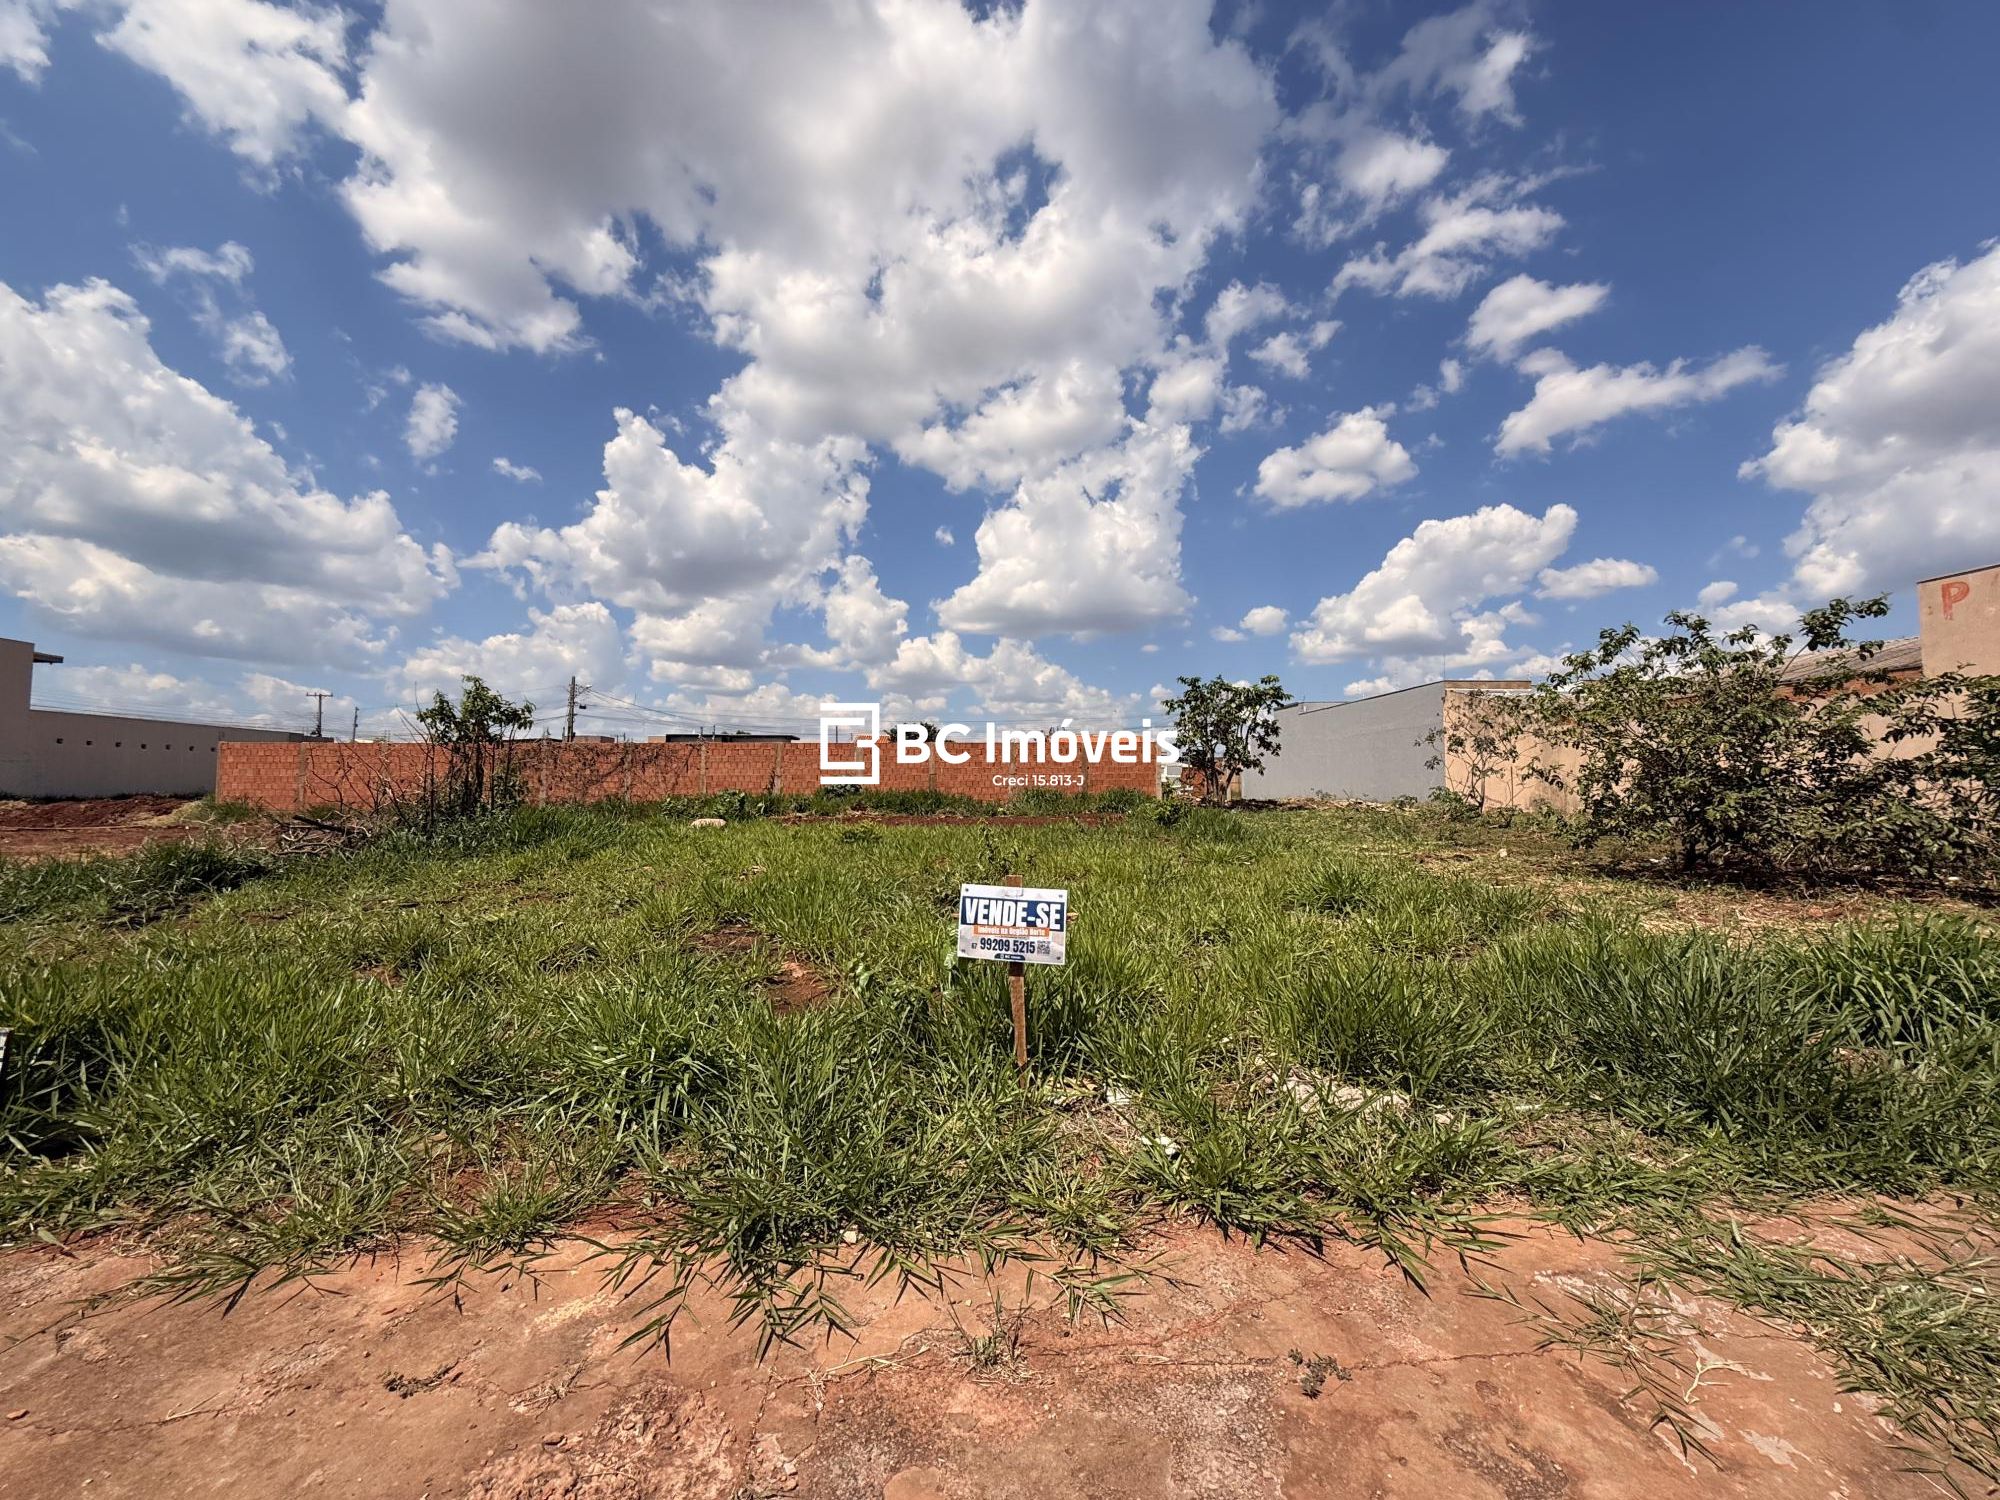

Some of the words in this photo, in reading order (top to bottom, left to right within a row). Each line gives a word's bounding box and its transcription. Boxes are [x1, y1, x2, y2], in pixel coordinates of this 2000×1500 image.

[1942, 581, 1969, 620] P
[965, 898, 1061, 930] VENDE-SE
[980, 937, 1010, 952] 99209
[1013, 940, 1036, 954] 5215
